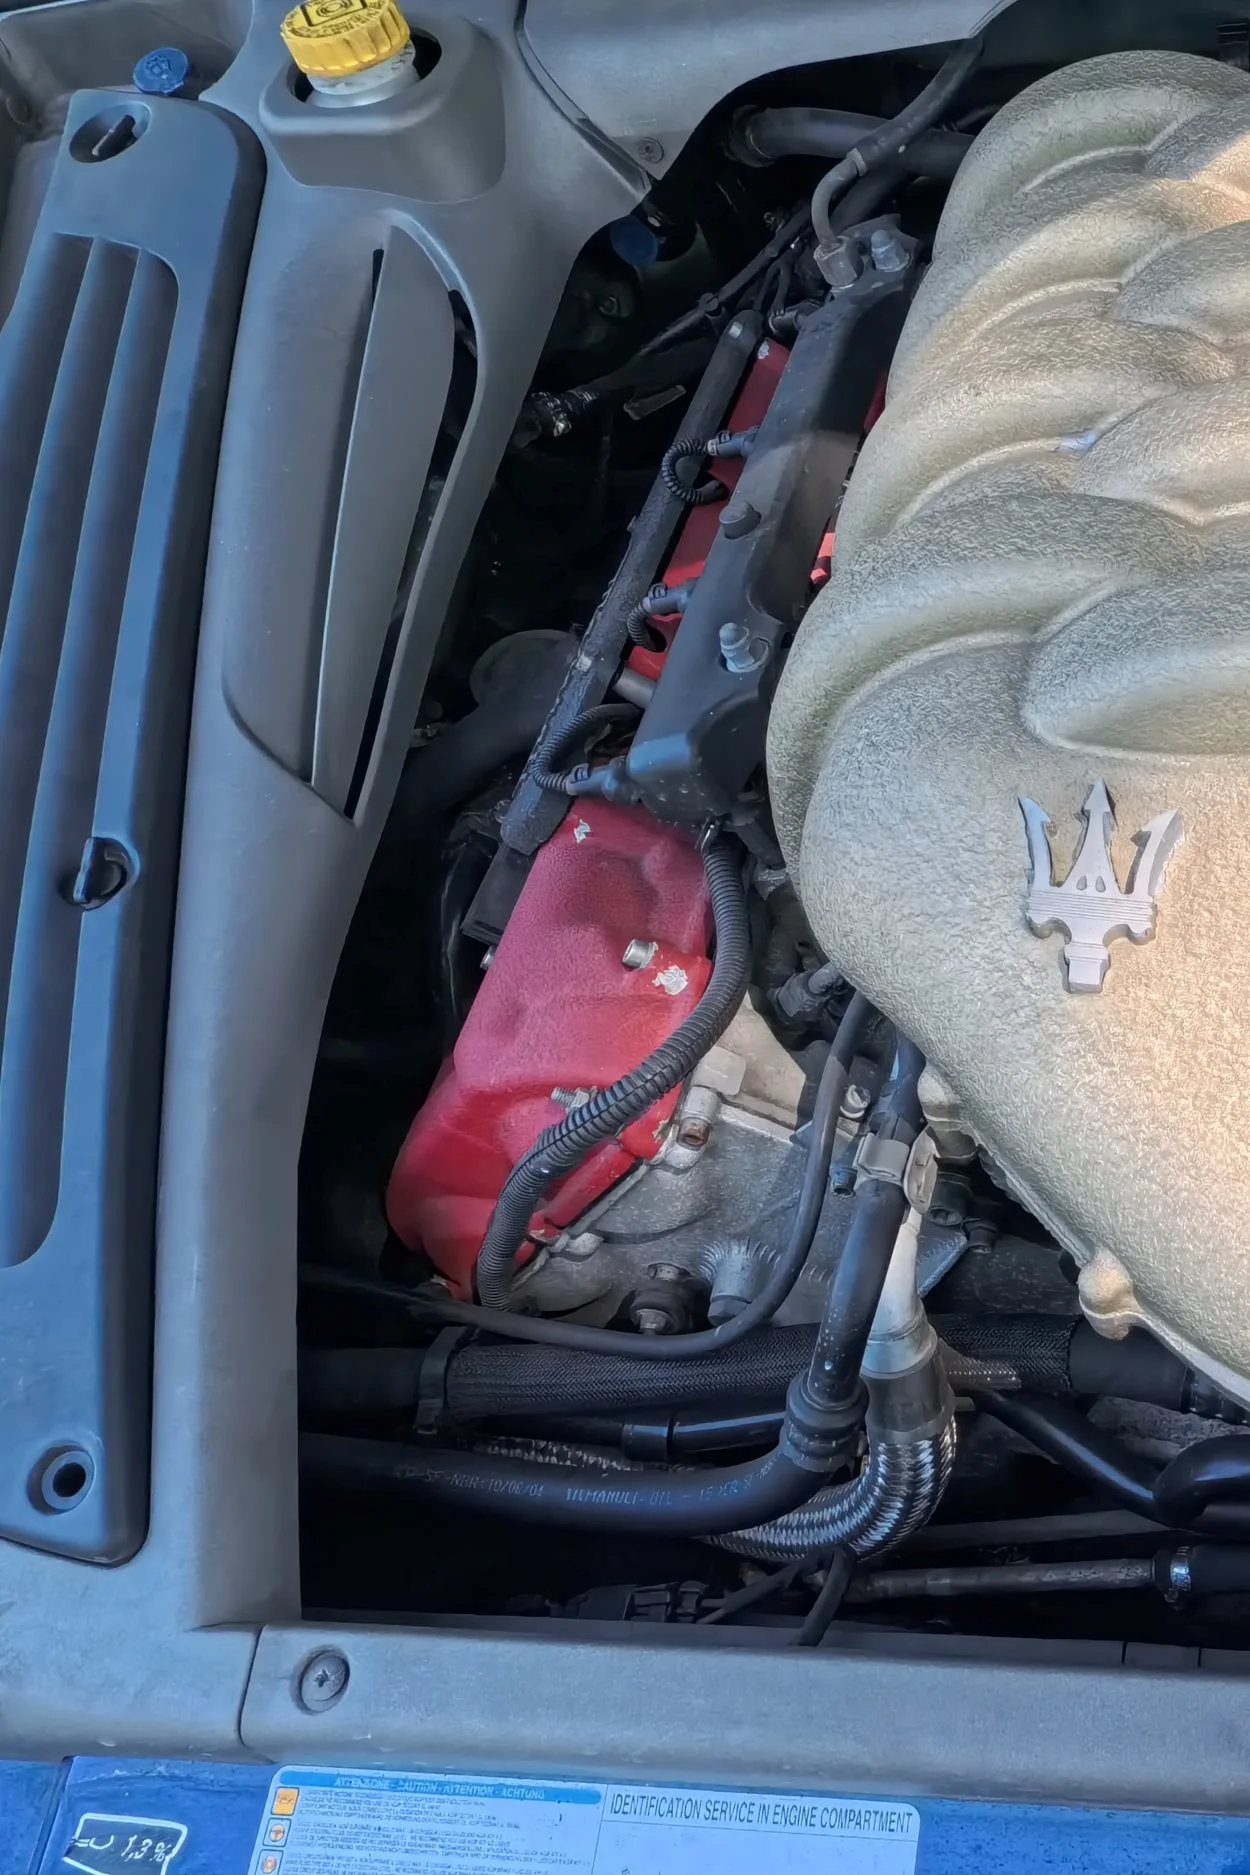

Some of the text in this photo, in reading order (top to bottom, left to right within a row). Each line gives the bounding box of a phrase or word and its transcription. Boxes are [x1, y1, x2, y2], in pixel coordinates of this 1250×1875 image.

[398, 1781, 438, 1793] CAUTION
[443, 1783, 495, 1797] ATTENTION
[501, 1786, 545, 1800] ACHTUNG
[610, 1793, 913, 1834] IDENTIFICATION SERVICE IN ENGINE COMPARTMENT
